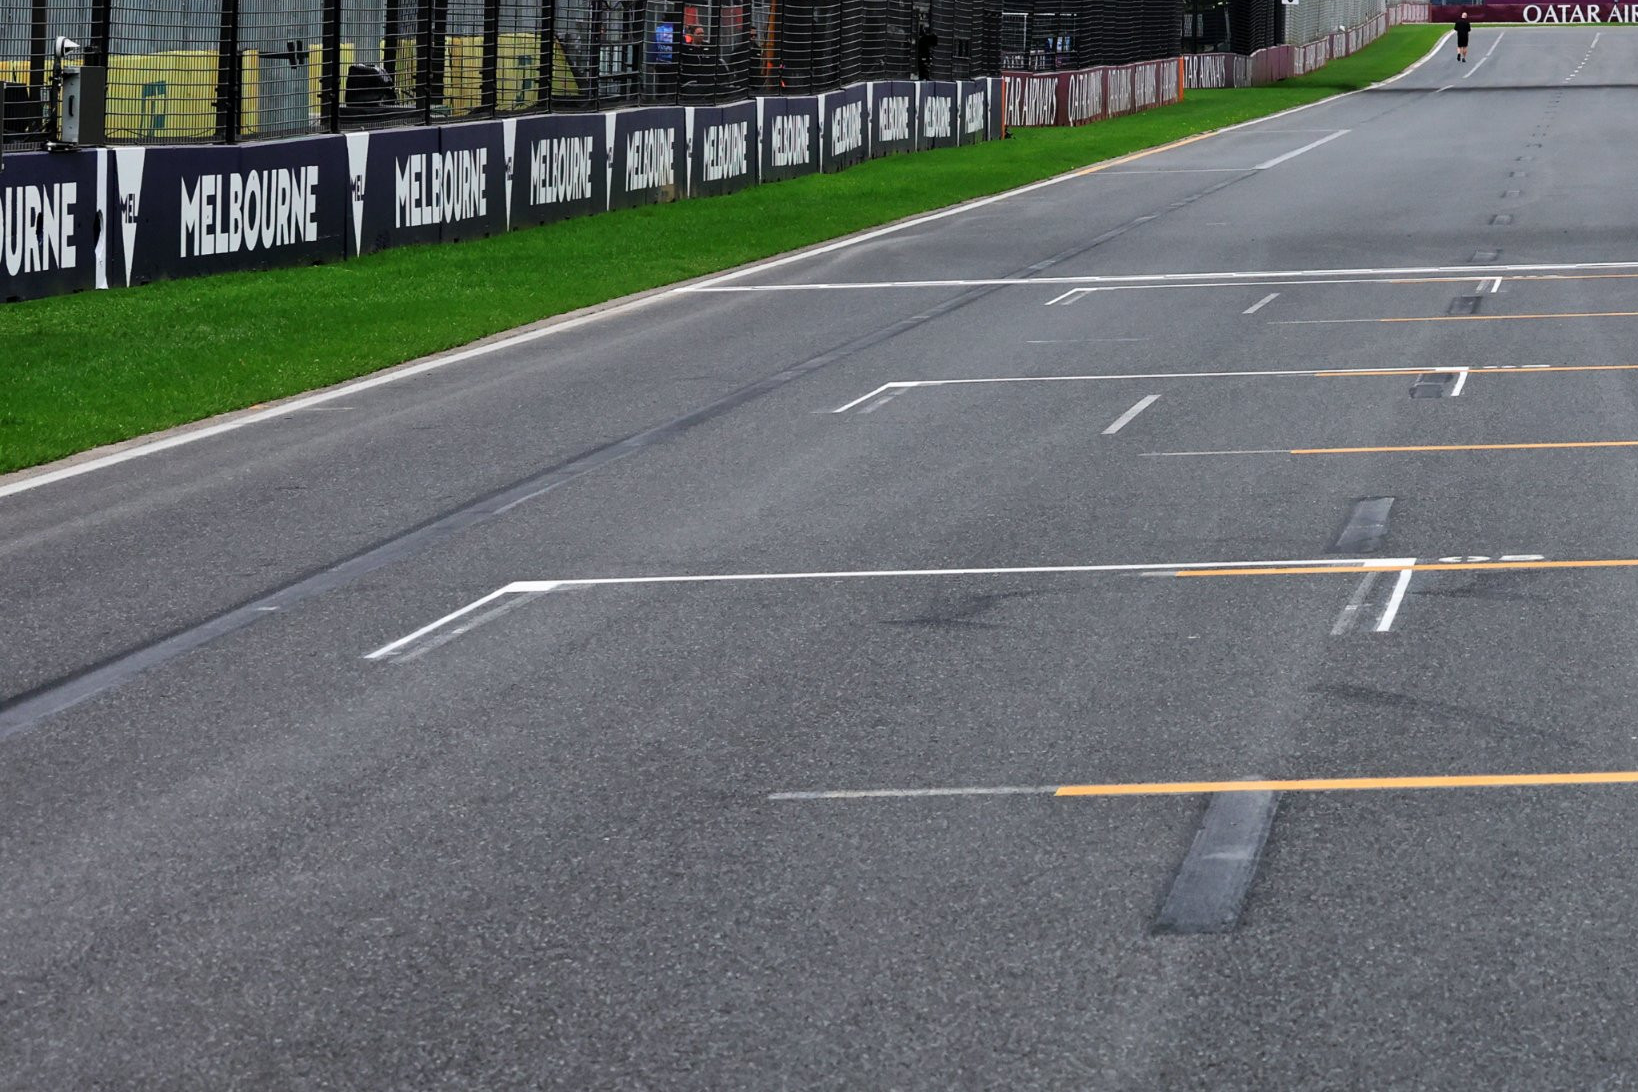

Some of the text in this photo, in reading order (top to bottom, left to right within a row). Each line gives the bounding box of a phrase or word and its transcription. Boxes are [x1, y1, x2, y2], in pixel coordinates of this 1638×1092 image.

[703, 121, 748, 182] MELBOURNE
[772, 115, 810, 167] MELBOURNE
[832, 100, 862, 157] MELBOURNE
[879, 96, 909, 142] MELBOURNE
[395, 148, 488, 229] MELBOURNE
[531, 136, 593, 206] MELBOURNE
[625, 127, 675, 192] MELBOURNE
[0, 182, 77, 277] URNE
[181, 166, 319, 258] MELBOURNE
